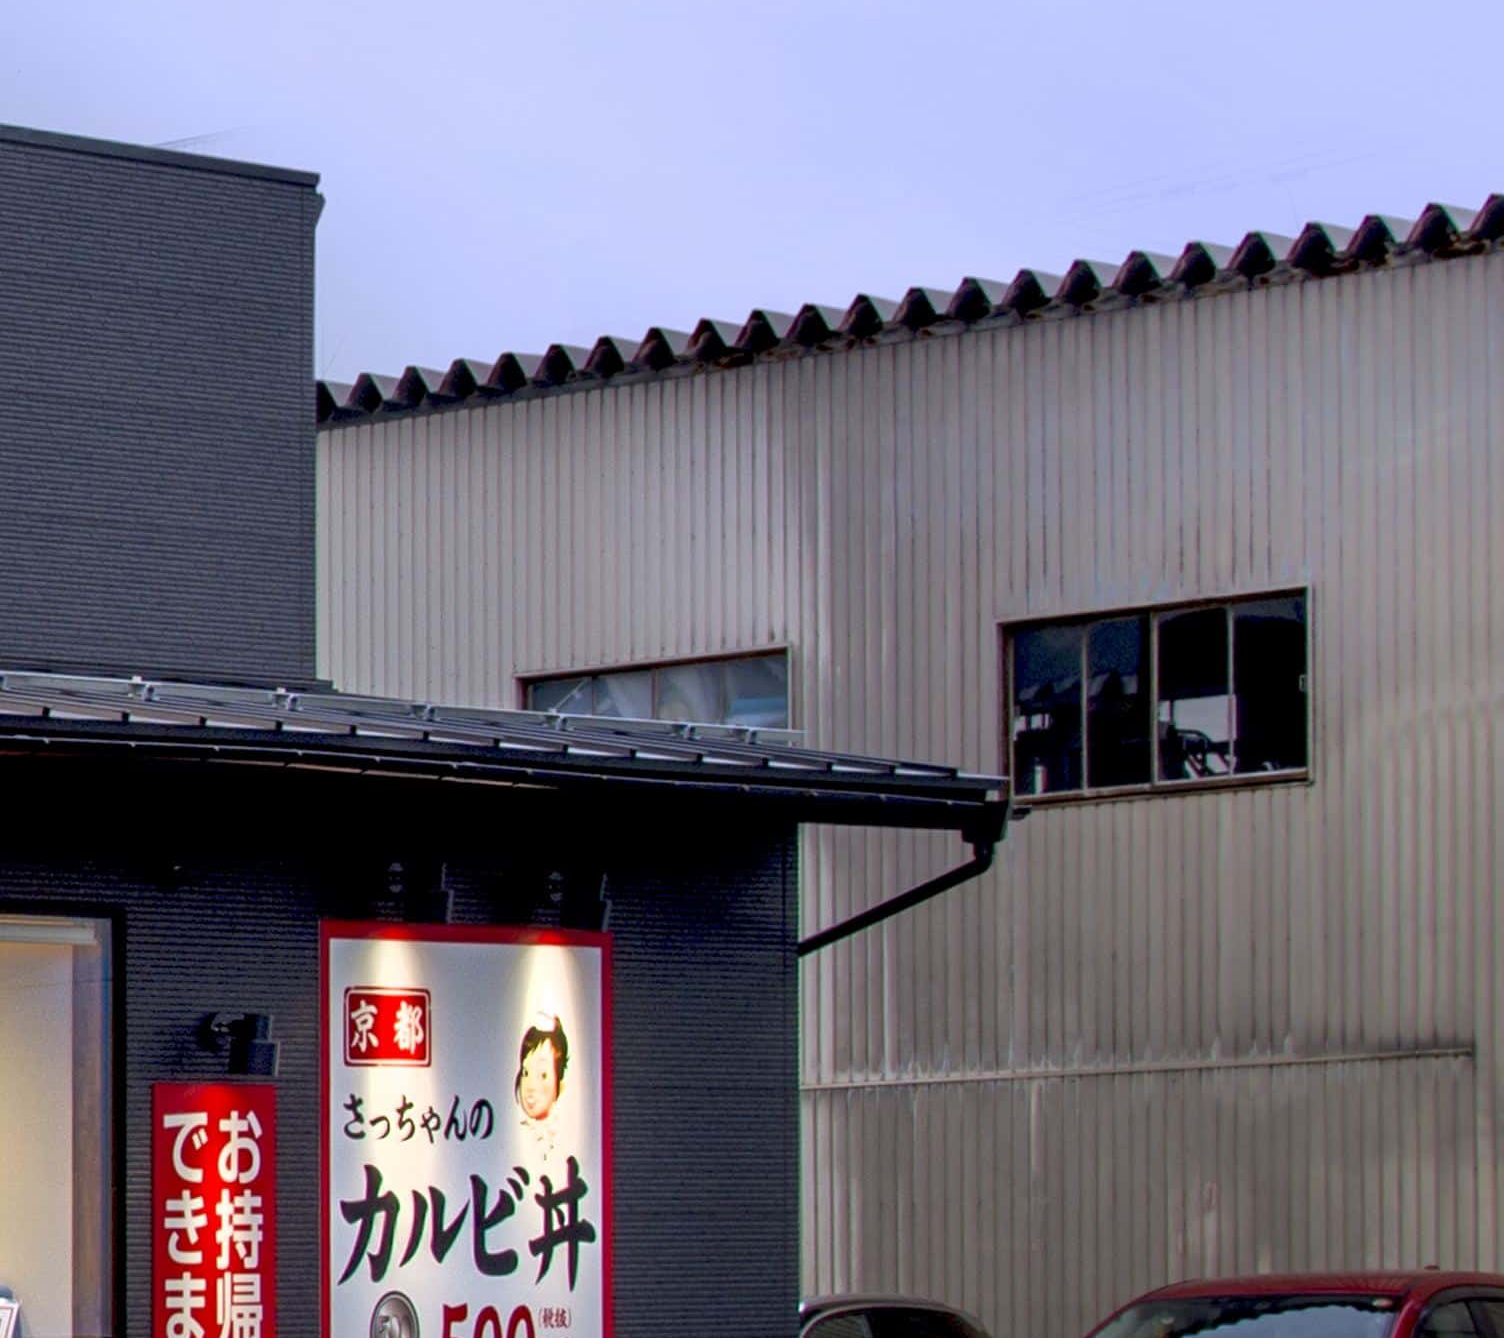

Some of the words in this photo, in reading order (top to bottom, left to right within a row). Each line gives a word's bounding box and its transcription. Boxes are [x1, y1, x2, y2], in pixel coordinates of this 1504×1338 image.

[350, 1000, 424, 1055] 京都
[342, 1092, 494, 1144] さっちゃんの
[337, 1156, 596, 1293] カルビ丼
